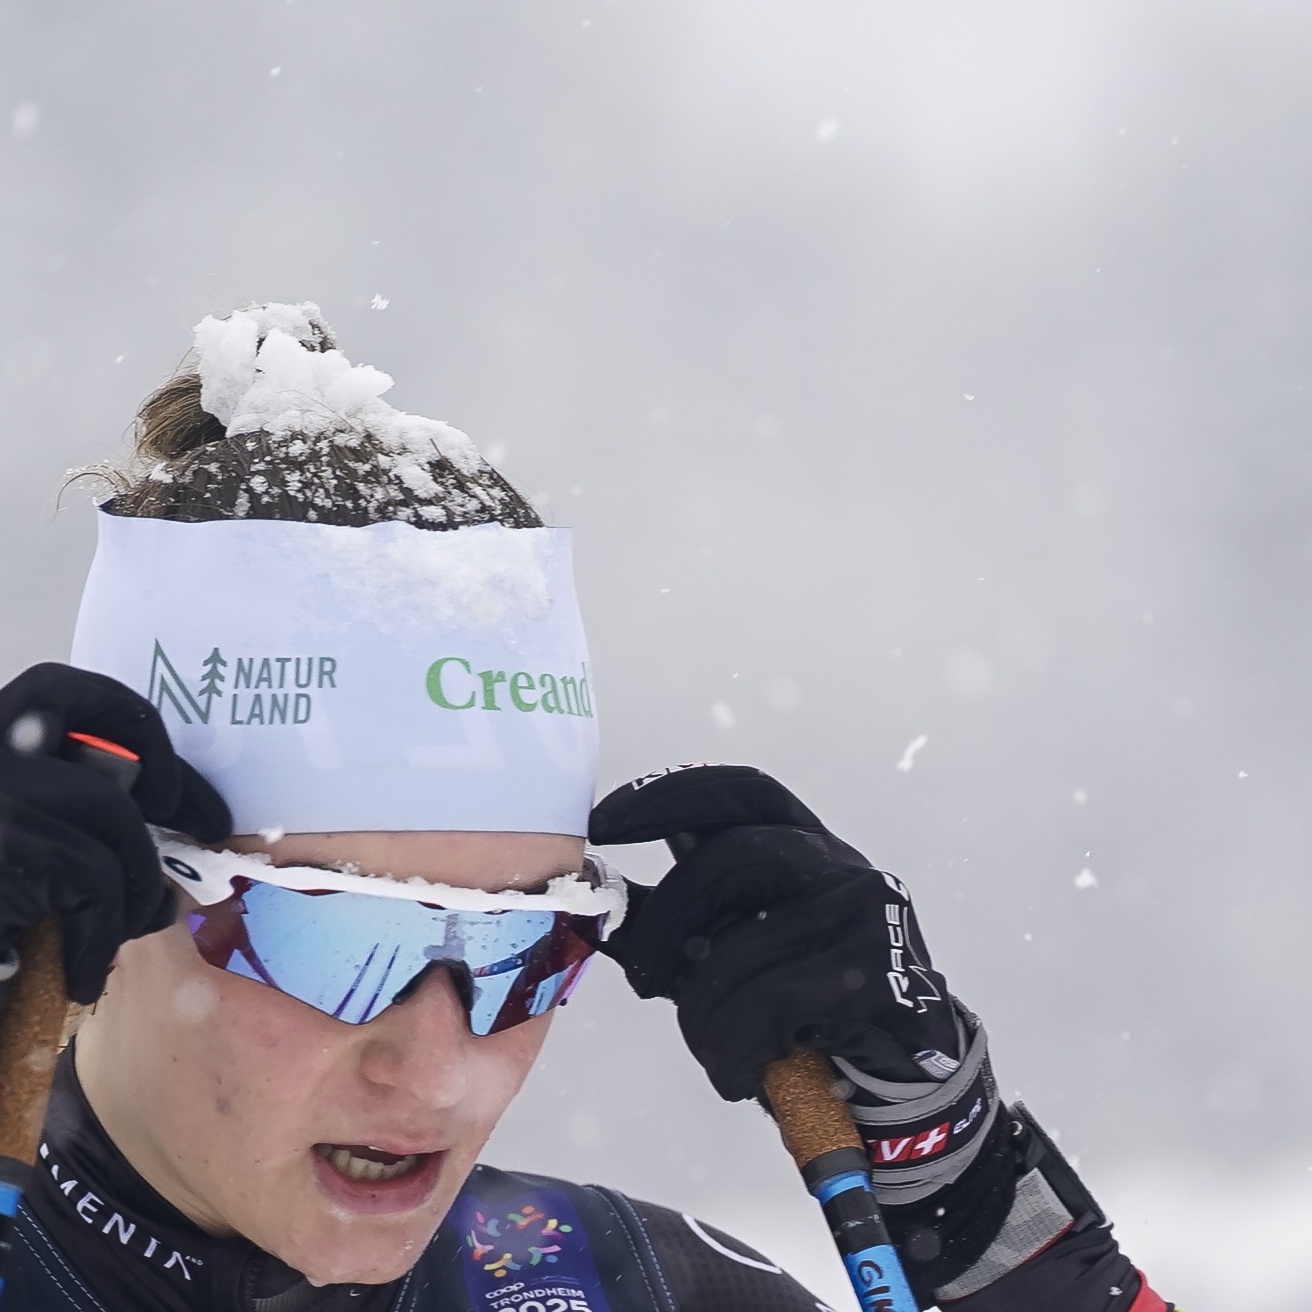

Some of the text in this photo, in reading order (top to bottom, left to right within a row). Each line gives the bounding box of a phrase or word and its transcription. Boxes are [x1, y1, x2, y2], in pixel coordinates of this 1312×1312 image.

[233, 656, 337, 689] NATUR
[230, 693, 312, 725] LAND
[885, 904, 914, 1008] RACE
[868, 1126, 947, 1161] V+
[485, 1282, 525, 1299] coop
[489, 1287, 585, 1309] TRONDHEIM
